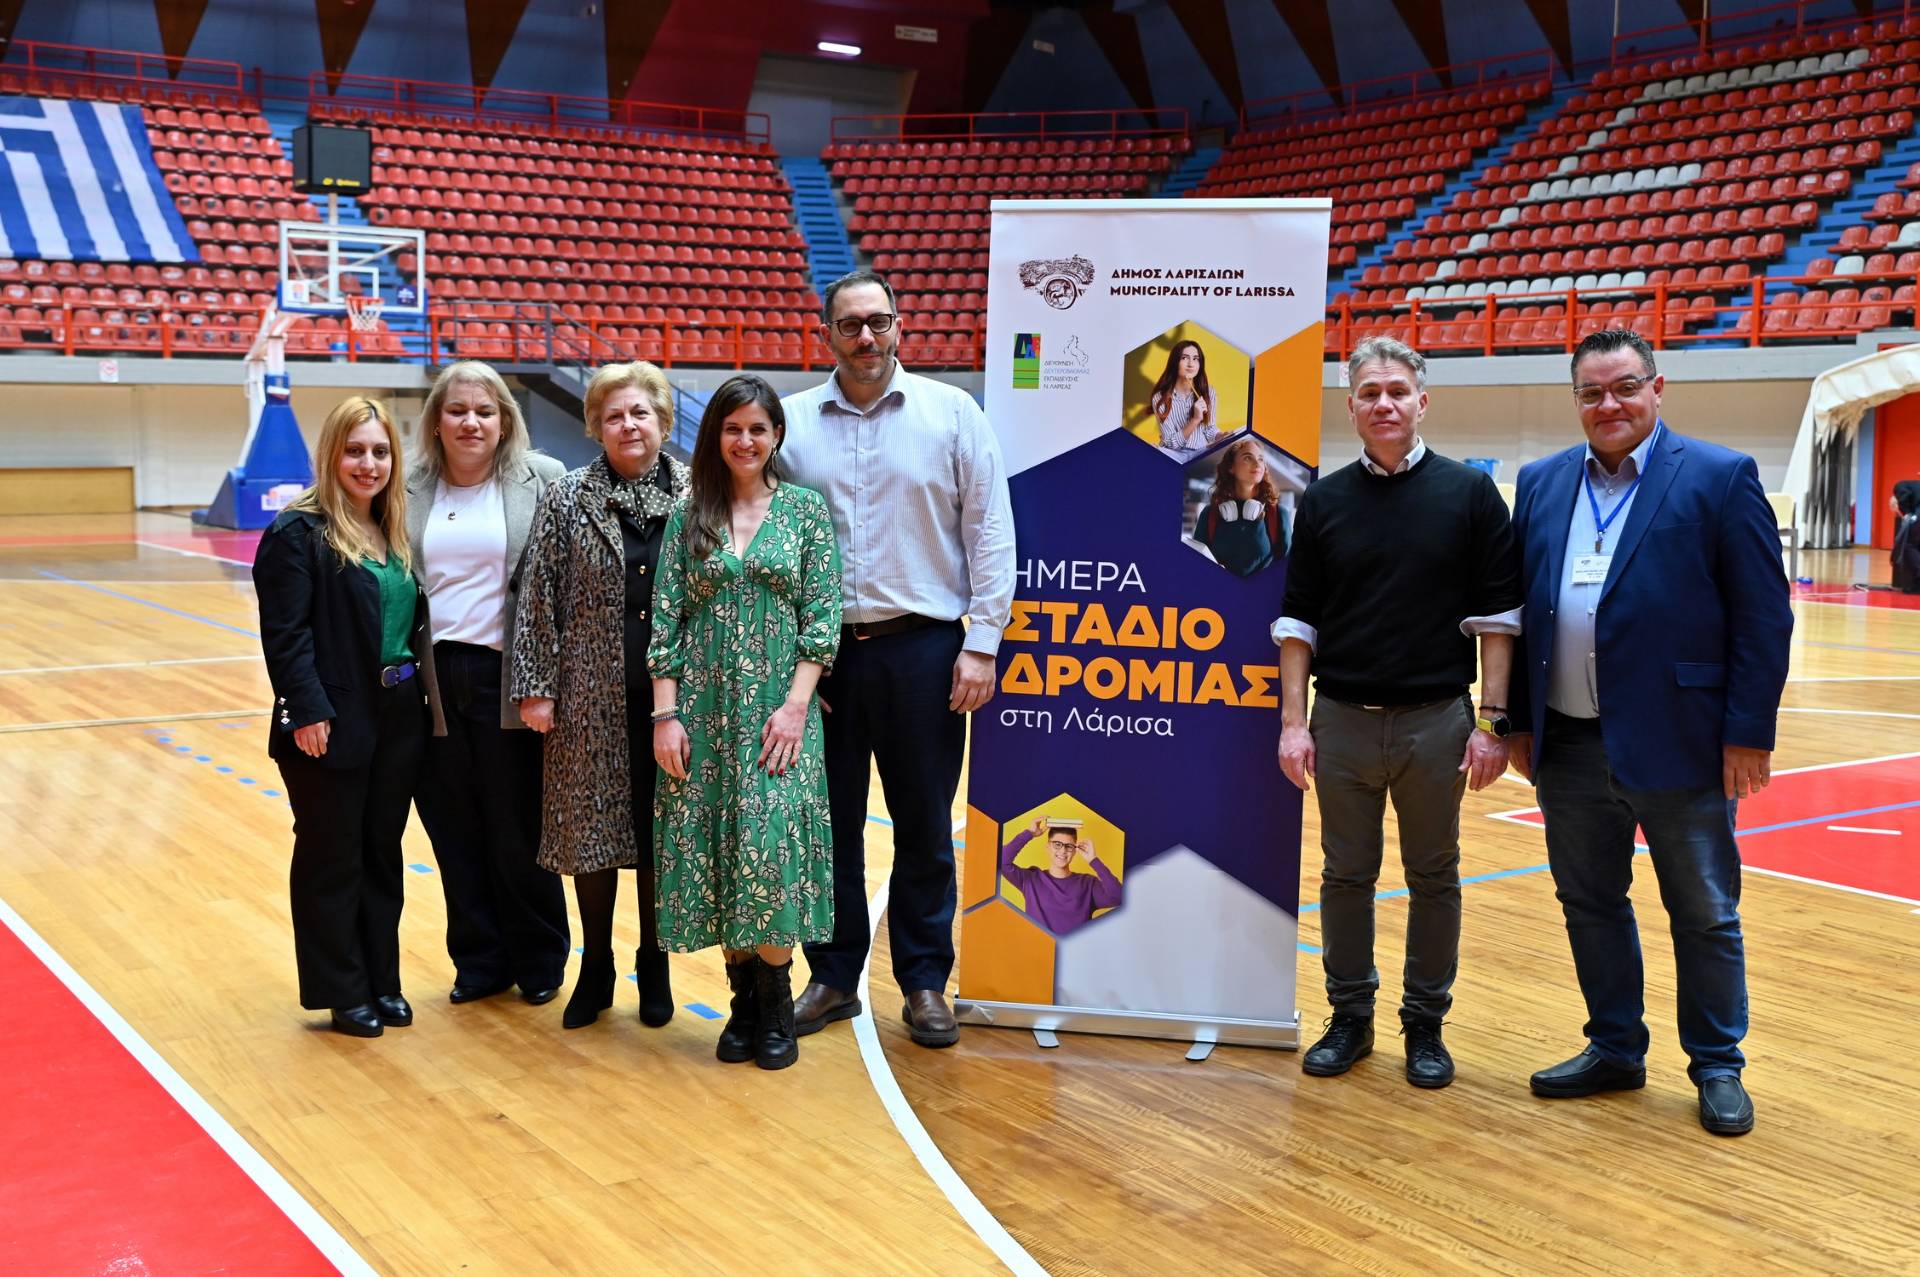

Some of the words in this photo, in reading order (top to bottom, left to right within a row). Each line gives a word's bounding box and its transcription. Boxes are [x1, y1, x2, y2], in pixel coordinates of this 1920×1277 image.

[1111, 269, 1162, 279] ΔΗΜΟΣ
[1165, 269, 1244, 280] ΛΑΡΙΣΑΙΩΝ
[1110, 286, 1210, 296] MUNICIPALITY
[1213, 286, 1233, 297] OF
[1236, 287, 1296, 297] LARISSA
[1003, 599, 1226, 651] ΣΤΑΔΙΟ
[1000, 652, 1280, 709] ΔΡΟΜΙΑΣ
[1000, 708, 1052, 733] στη
[1063, 706, 1175, 737] Λάρισα
